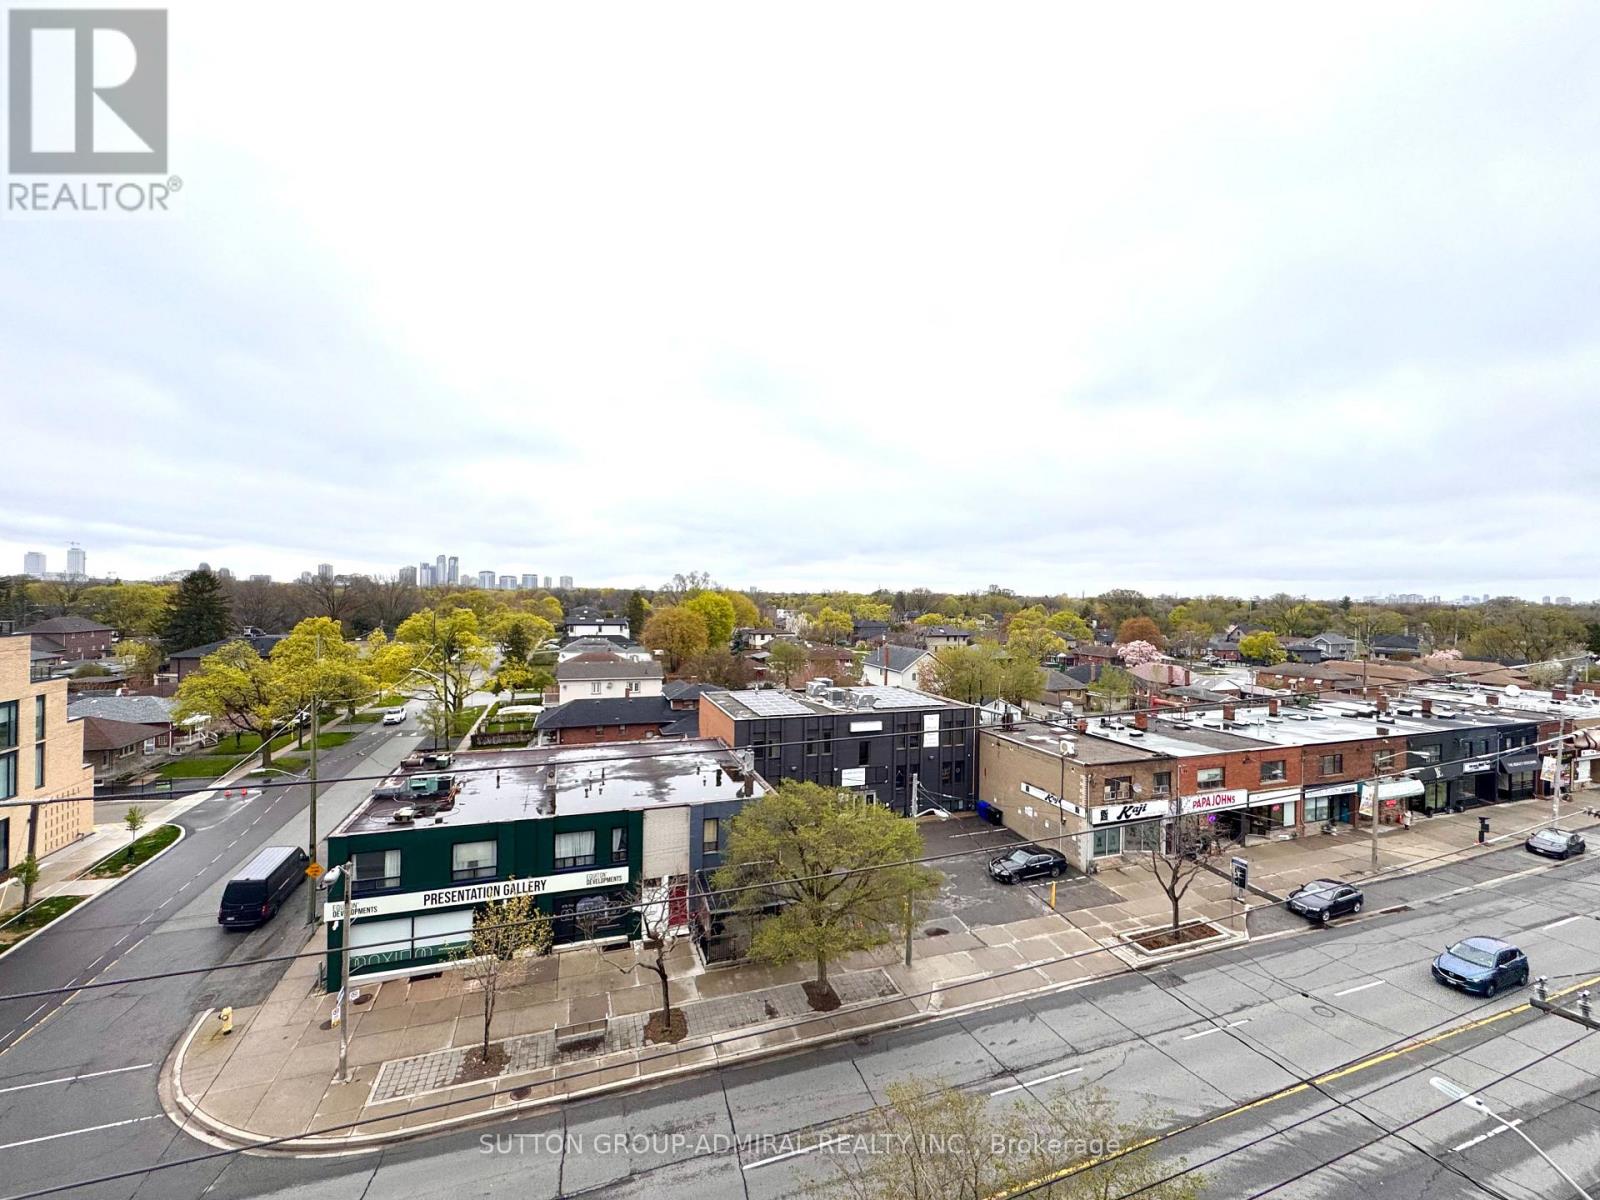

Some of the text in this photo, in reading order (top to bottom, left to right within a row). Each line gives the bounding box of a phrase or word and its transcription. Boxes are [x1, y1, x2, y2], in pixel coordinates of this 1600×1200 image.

[1193, 796, 1211, 809] PAPA
[1116, 803, 1148, 820] Kaji
[423, 879, 547, 906] PRESENTATION GALLERY
[332, 905, 378, 918] DEVOPMENTS
